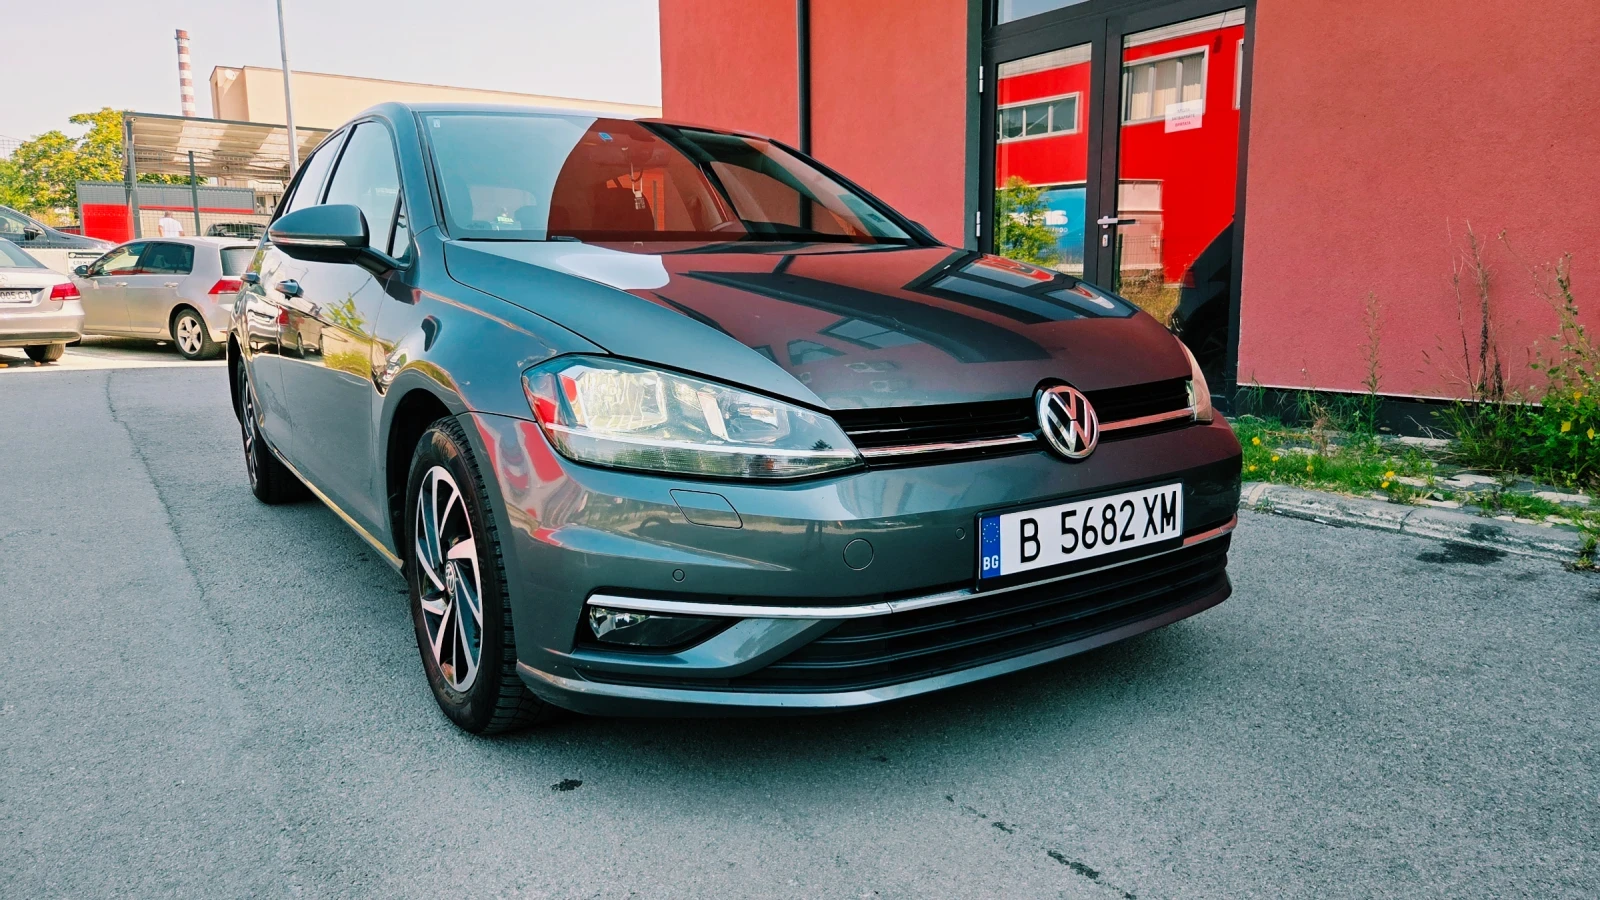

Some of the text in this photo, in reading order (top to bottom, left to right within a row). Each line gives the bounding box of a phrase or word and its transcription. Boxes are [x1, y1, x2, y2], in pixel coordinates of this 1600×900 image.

[1019, 490, 1177, 564] B 5682 XM
[983, 555, 999, 571] BG
